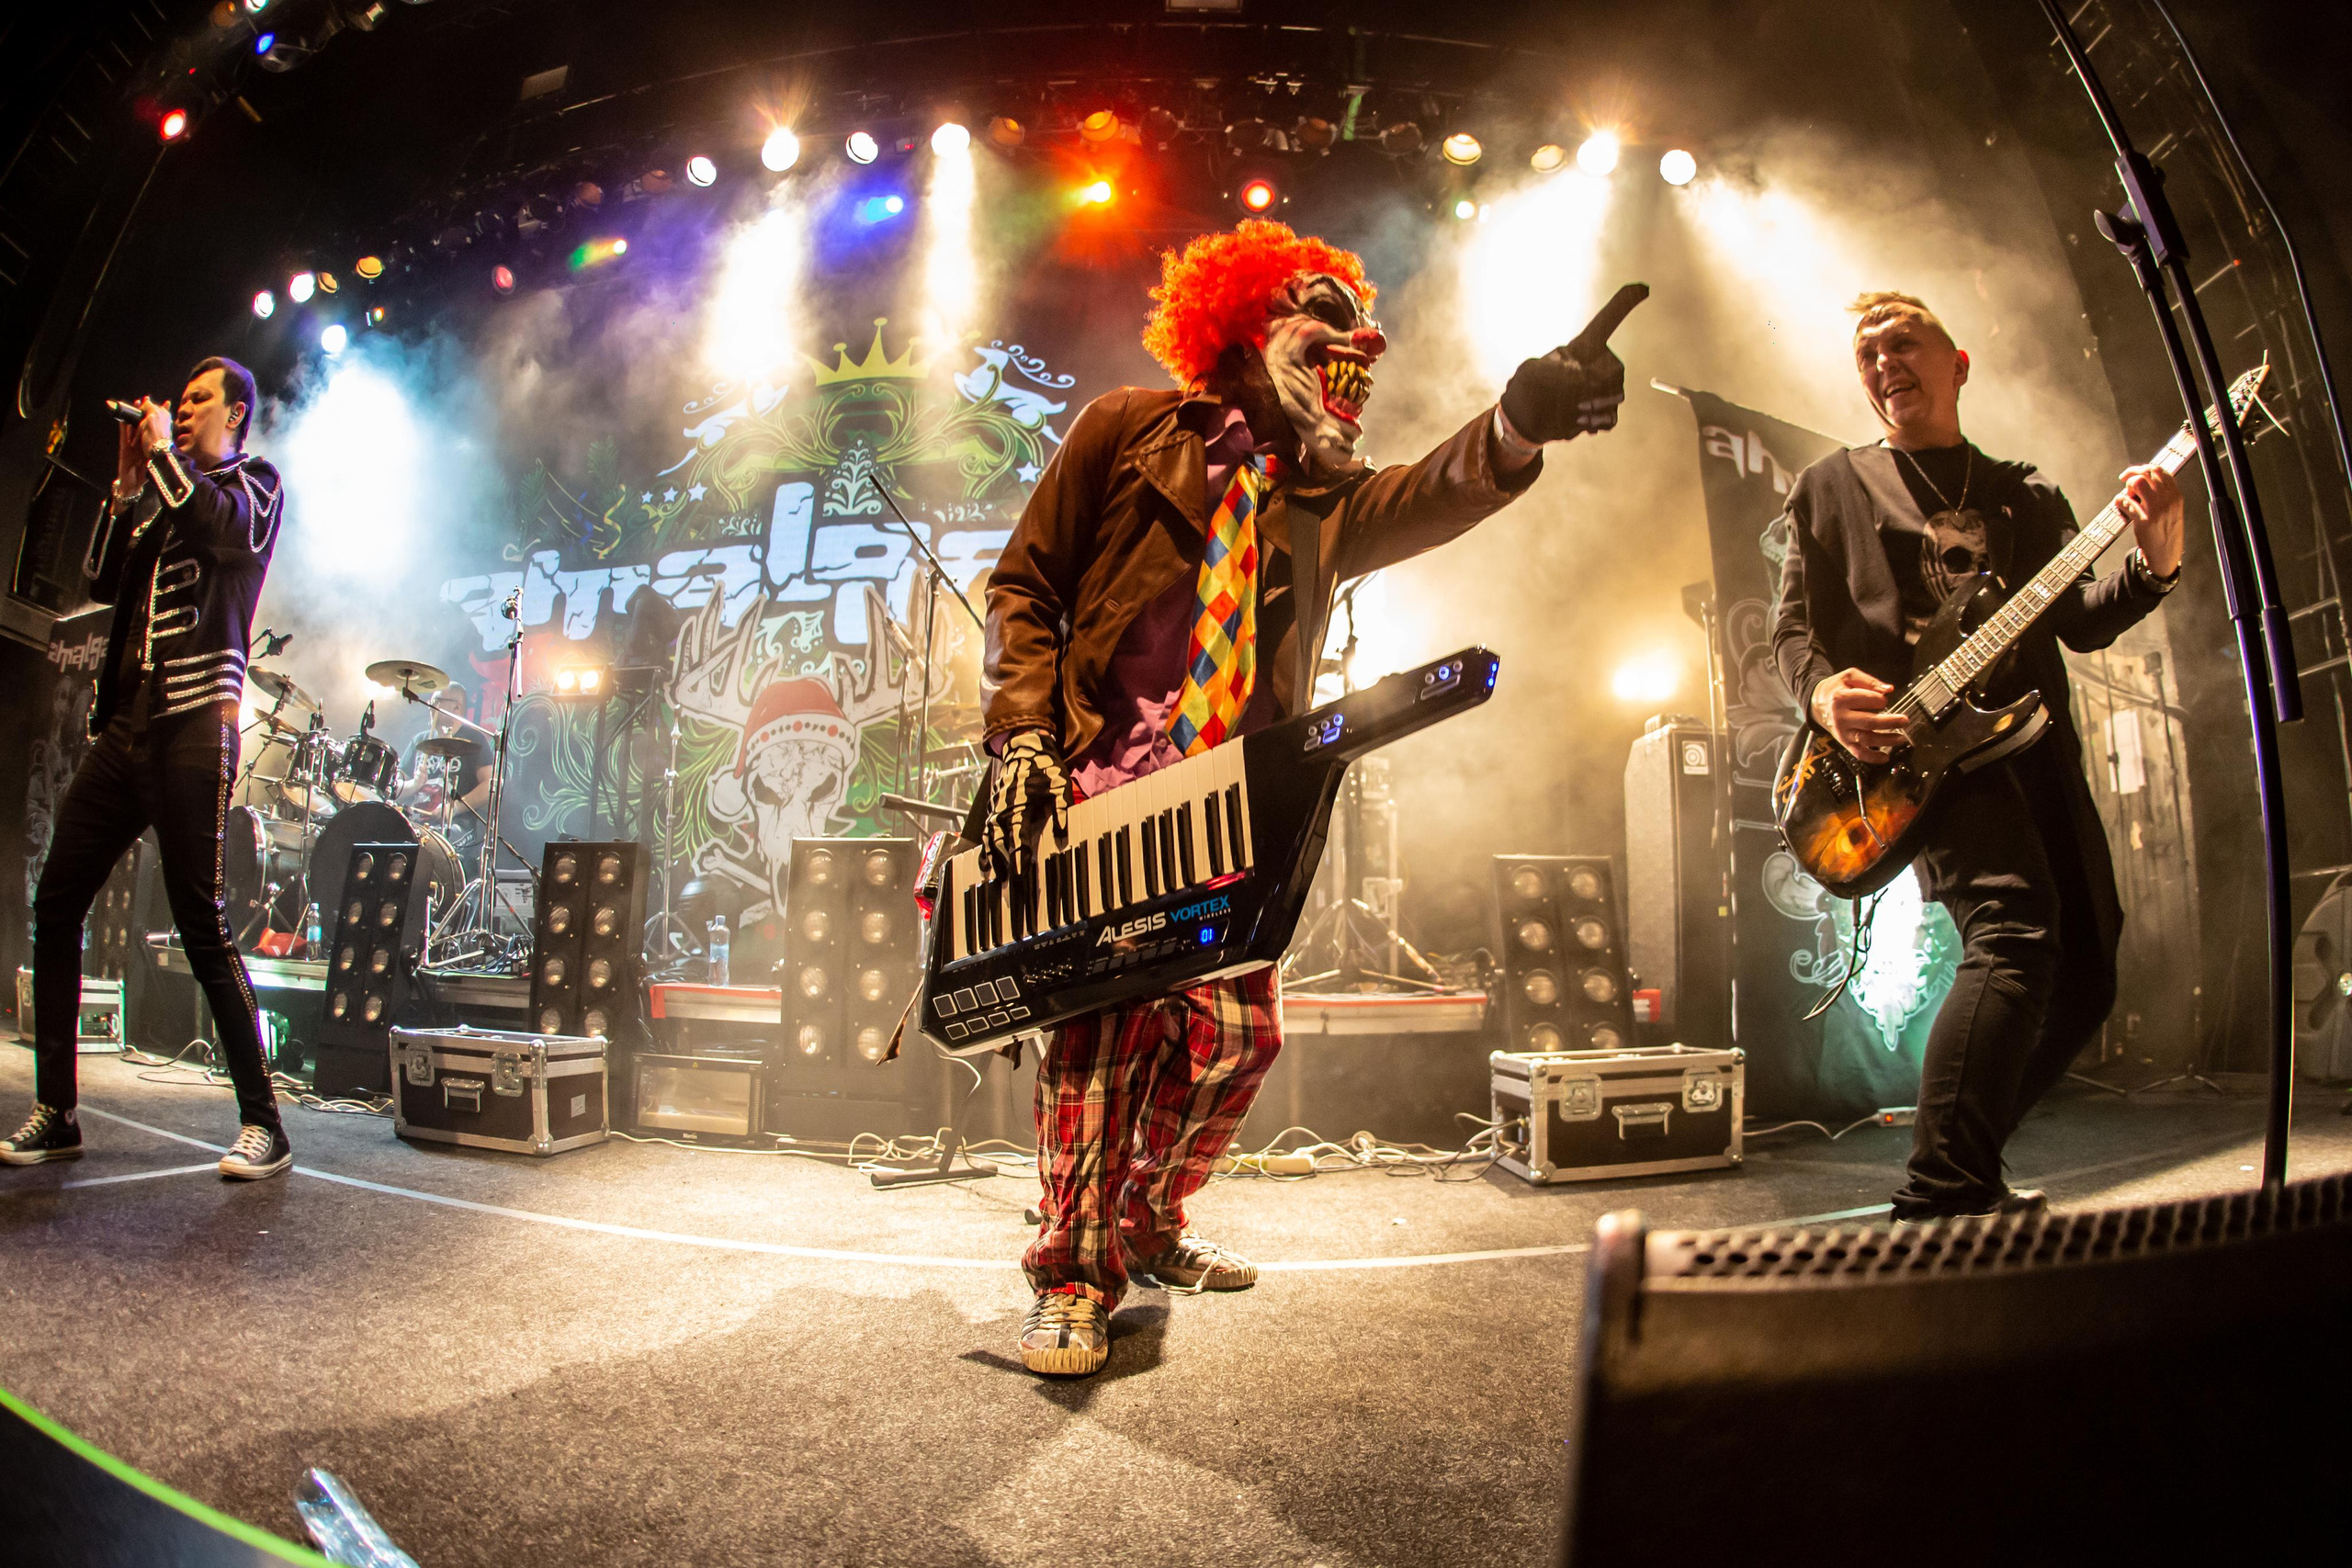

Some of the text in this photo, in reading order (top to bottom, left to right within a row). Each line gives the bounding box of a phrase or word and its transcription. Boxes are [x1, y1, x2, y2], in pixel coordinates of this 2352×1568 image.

[1702, 424, 1802, 495] am
[1095, 911, 1167, 948] ALESIS
[1170, 894, 1230, 924] VORTEX
